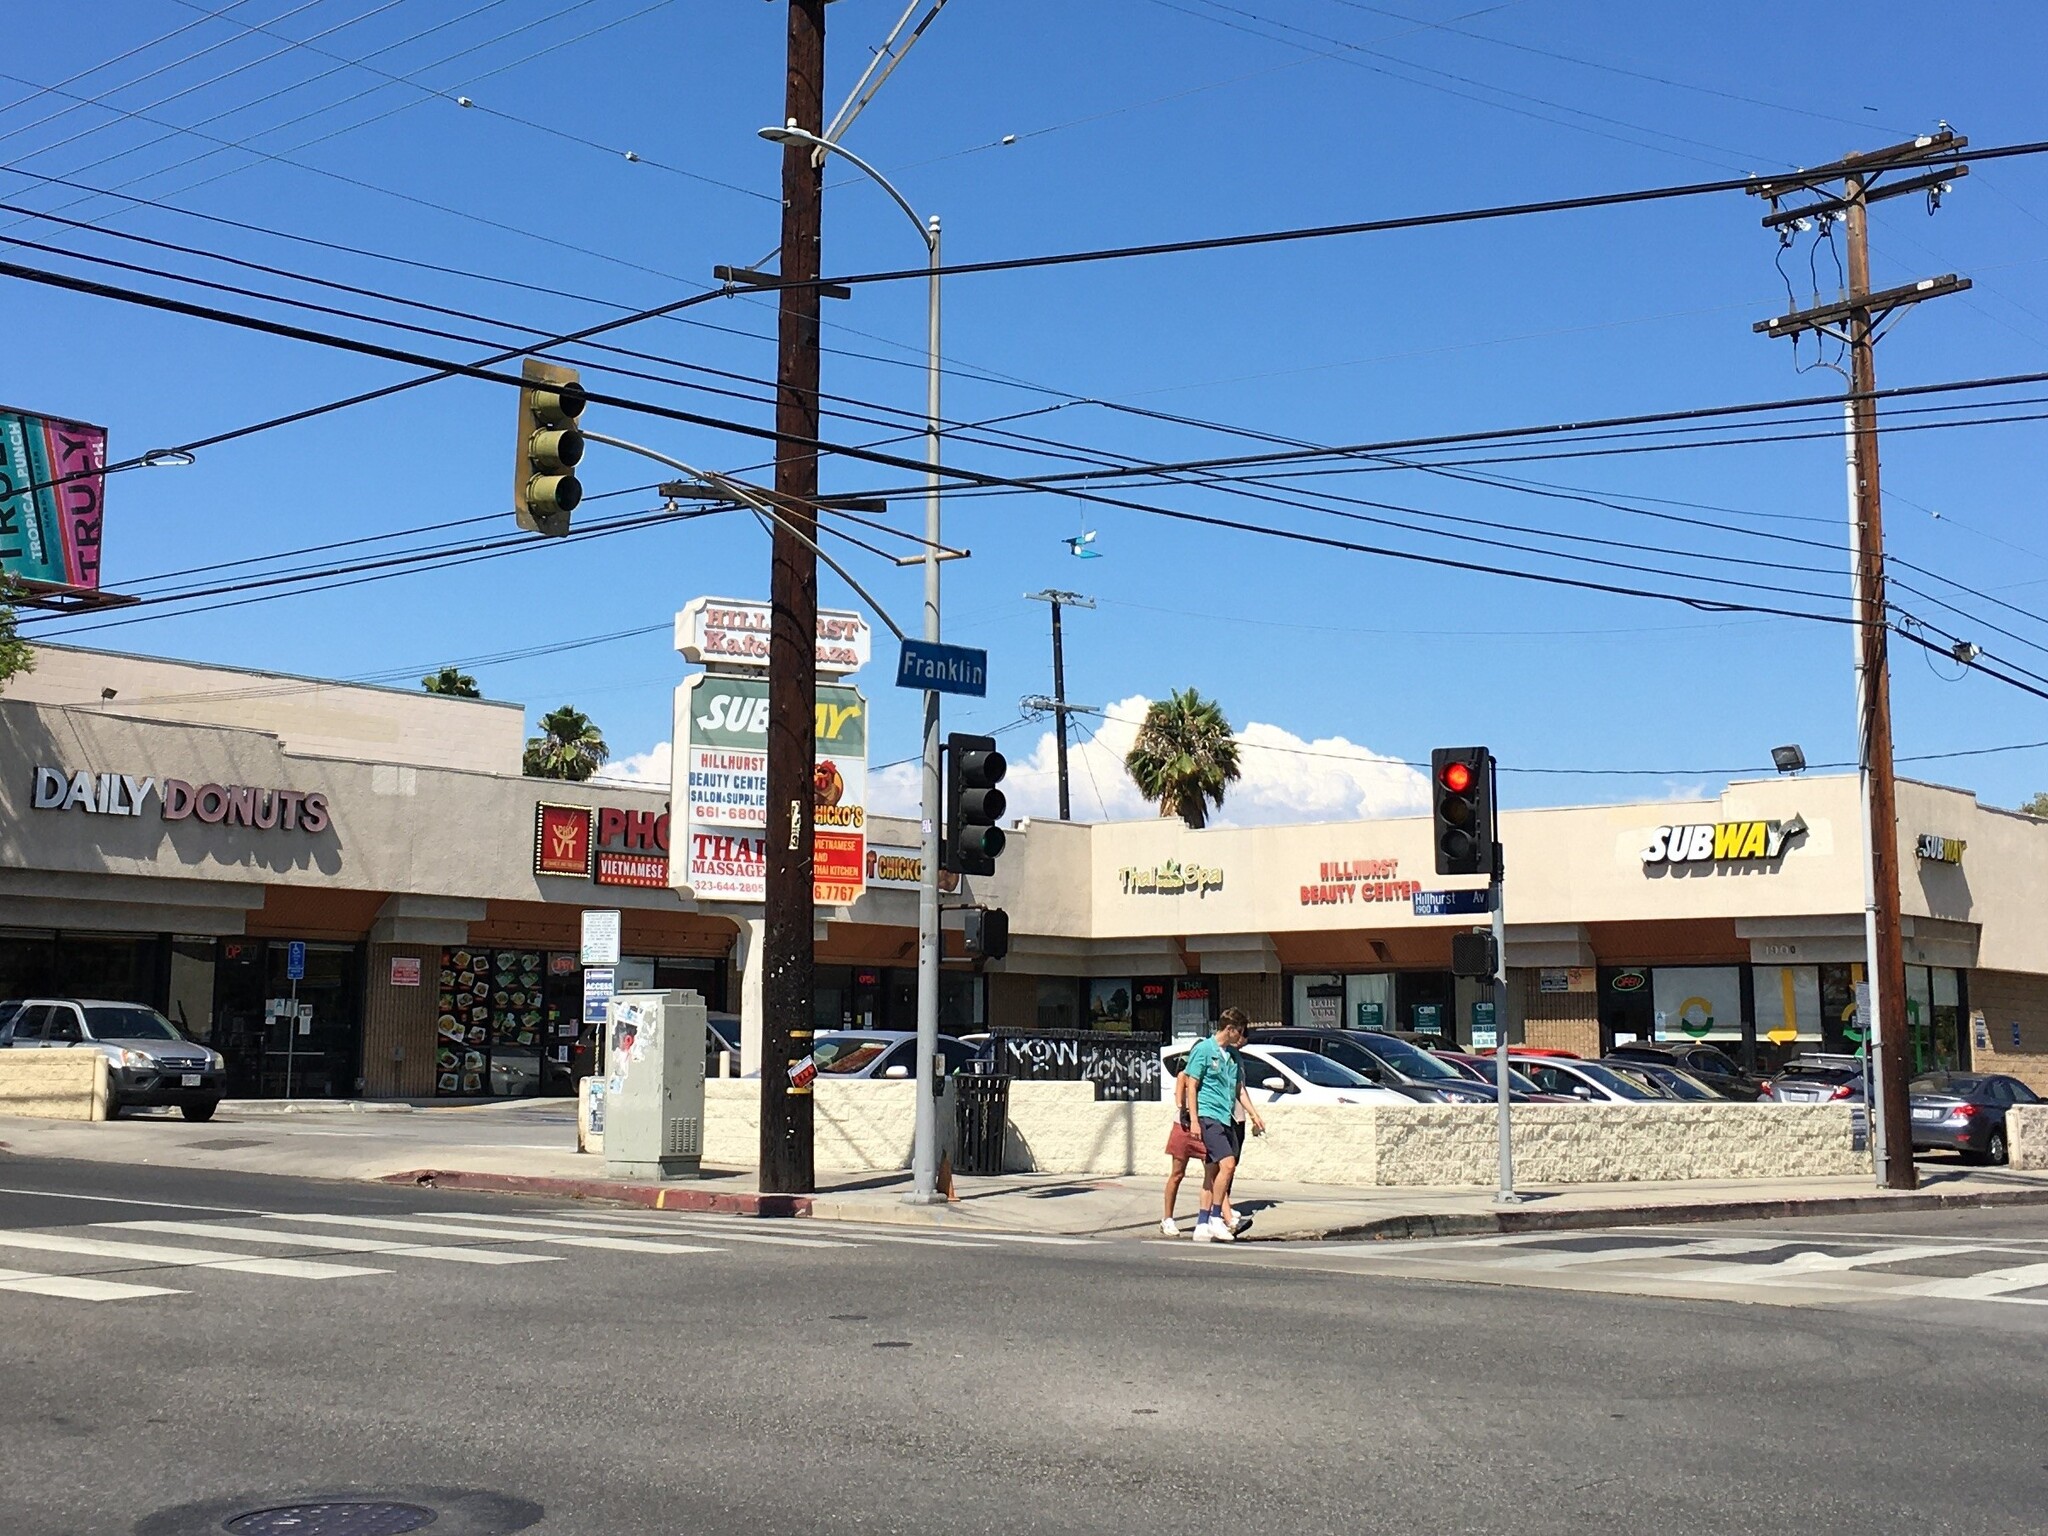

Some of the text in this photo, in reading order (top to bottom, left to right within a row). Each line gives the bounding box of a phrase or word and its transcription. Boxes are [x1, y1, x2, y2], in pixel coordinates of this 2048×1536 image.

[9, 421, 29, 478] PUNCH
[58, 432, 100, 582] TRULY
[706, 609, 859, 641] HILLRST
[903, 652, 983, 685] Franklin
[697, 695, 862, 738] SUBY
[701, 753, 765, 771] HILLHURST
[690, 772, 730, 789] BEAUTY
[34, 766, 329, 832] DAILY DONUTS
[814, 805, 864, 829] HICKO'S
[814, 839, 856, 851] VIETNAMESE
[1640, 812, 1808, 863] SUBWAY
[552, 838, 577, 858] VT
[693, 833, 766, 864] THAI
[814, 852, 828, 863] AND
[1916, 834, 1967, 863] SUBWAY
[600, 859, 664, 879] VIETNAMESE
[692, 860, 766, 878] MASSAGE
[814, 864, 859, 877] THAI KITCHEN
[1320, 860, 1398, 880] HILLHURST
[695, 880, 764, 893] 323-644-2805
[1119, 864, 1222, 895] Thai Spa
[1300, 884, 1355, 905] BEAUTY
[1415, 889, 1484, 905] Hillhurst Av
[1415, 905, 1439, 914] 1900 N
[1765, 944, 1796, 956] 1900
